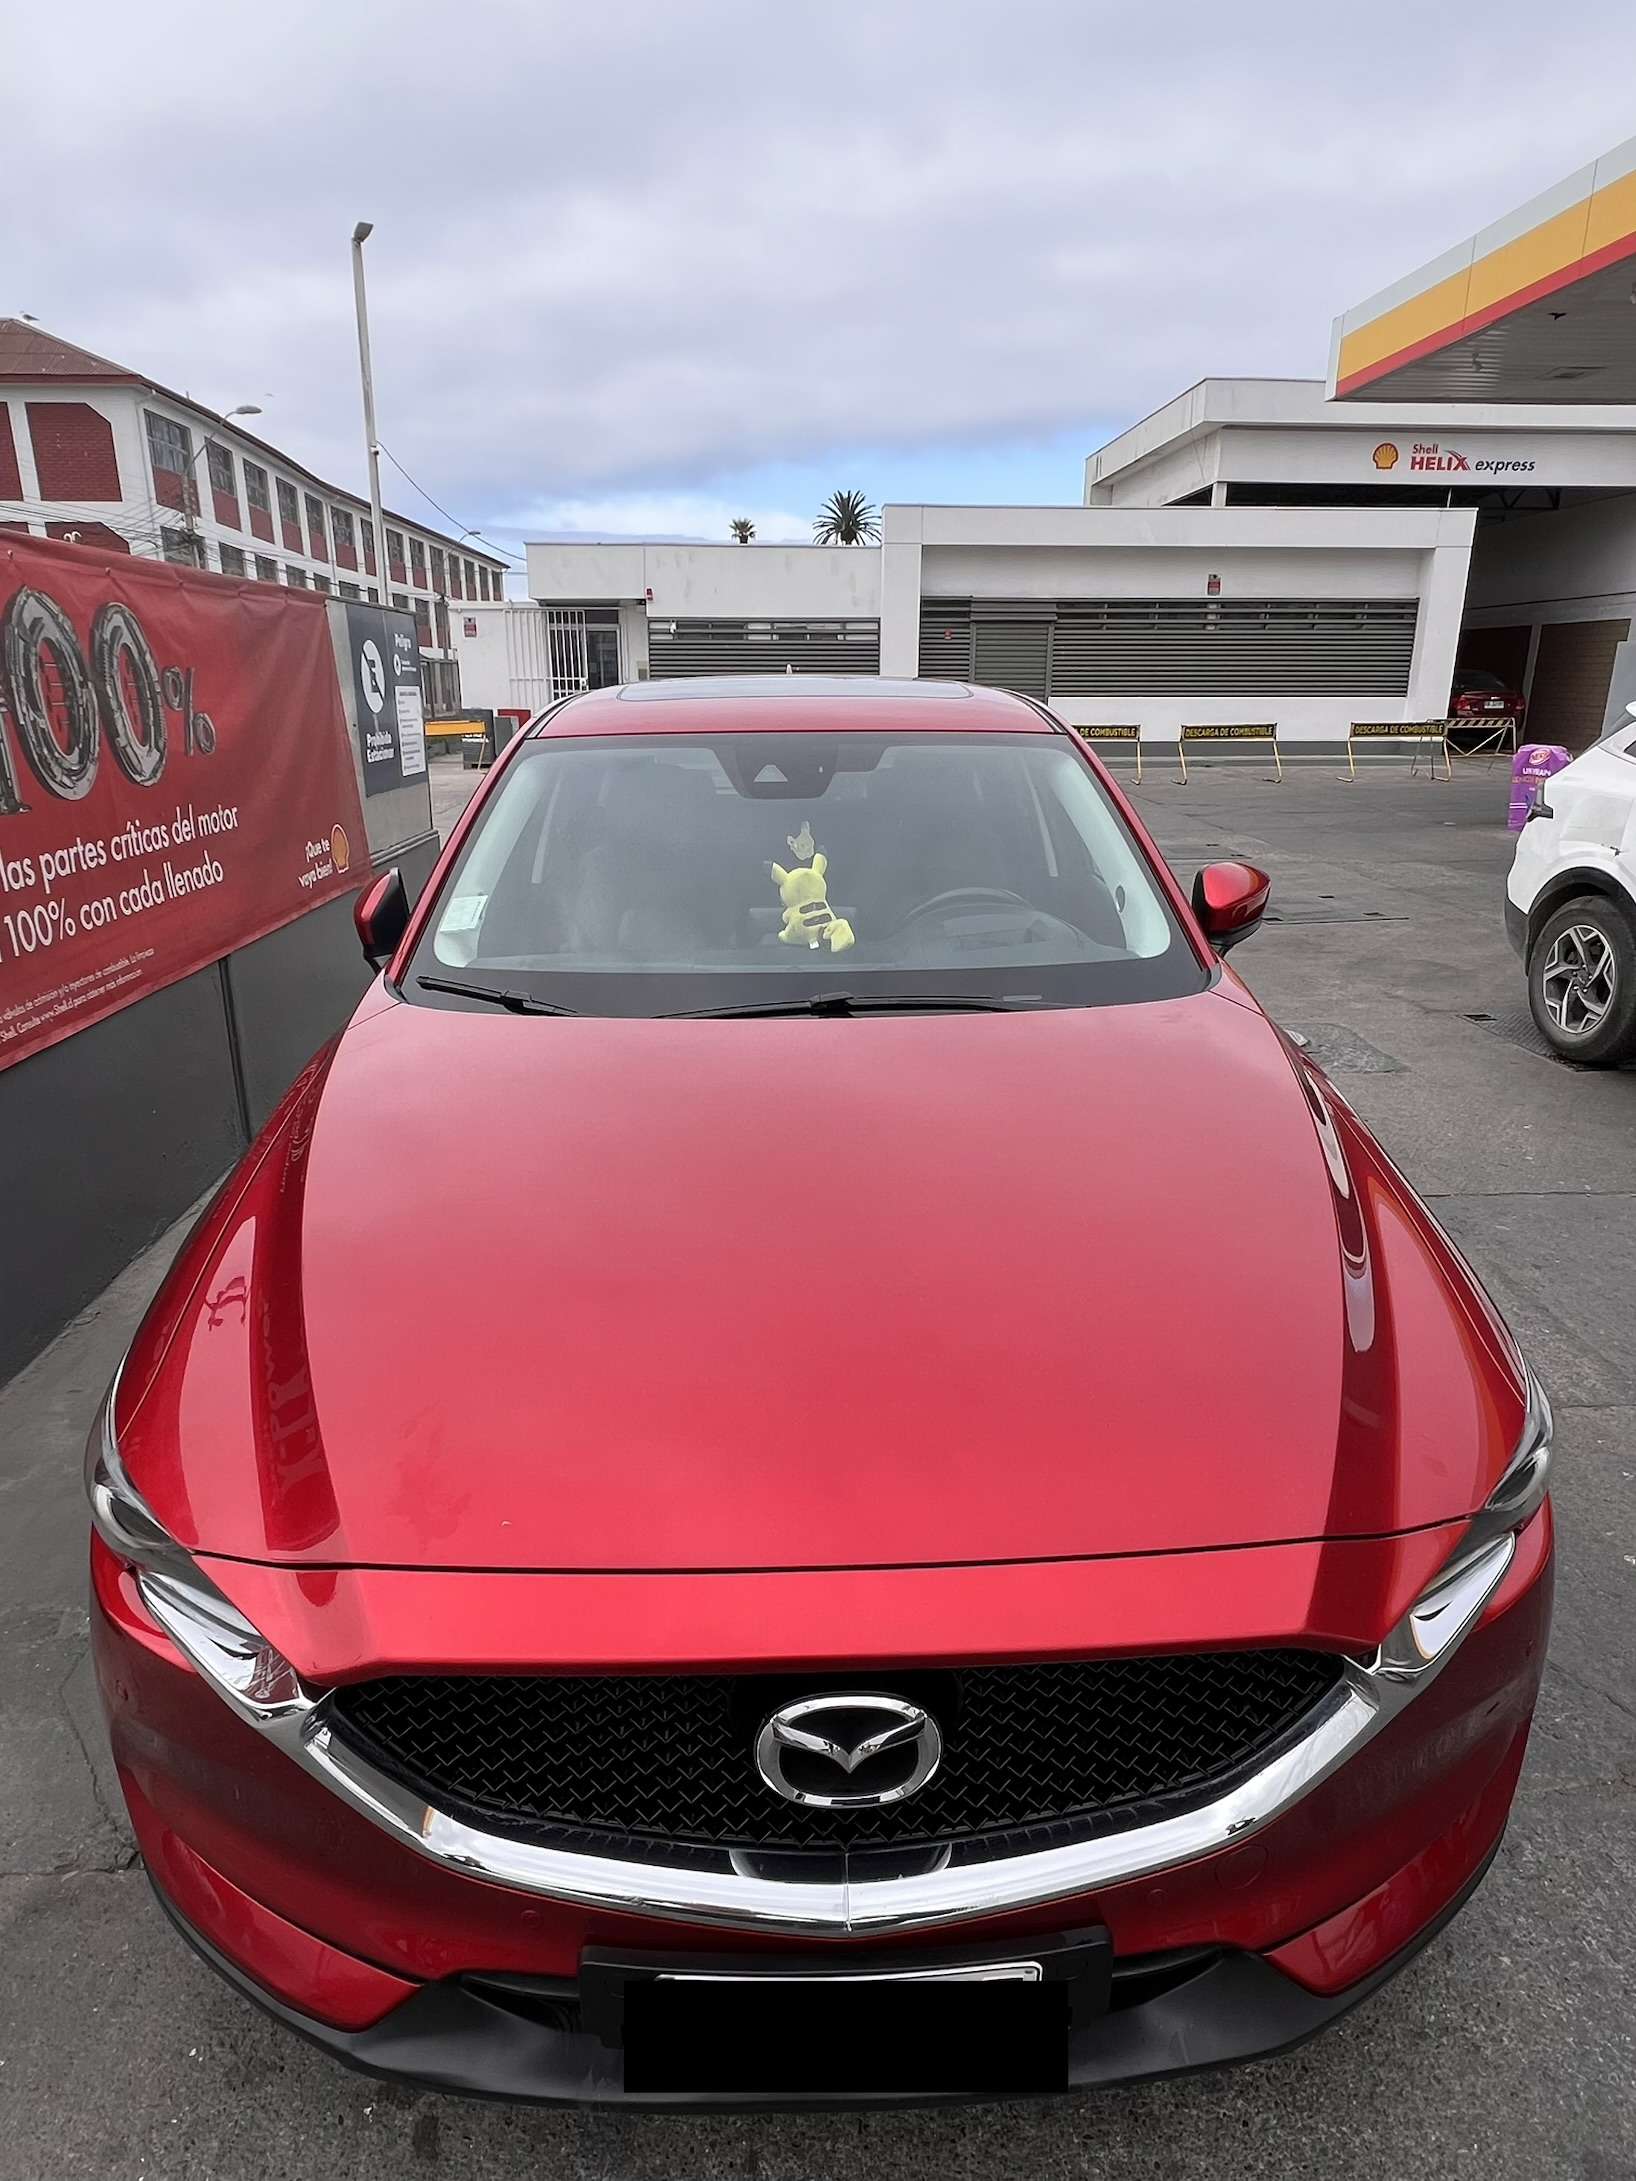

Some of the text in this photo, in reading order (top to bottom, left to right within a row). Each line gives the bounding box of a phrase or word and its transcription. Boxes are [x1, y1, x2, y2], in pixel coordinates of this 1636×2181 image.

[1412, 443, 1439, 454] Shell
[1410, 455, 1536, 475] HELIX express
[1080, 727, 1136, 737] DE COMBUSTIBLE
[1185, 726, 1273, 738] DESCARGA DE COMBUSTIBLE
[1354, 724, 1443, 735] DESCARGA DE COMBUSTIBLE
[39, 837, 107, 894] partes
[111, 819, 170, 861] críticas
[172, 804, 196, 844] del
[199, 804, 239, 837] motor
[321, 838, 331, 853] te
[3, 850, 224, 957] 100% con cada llenado
